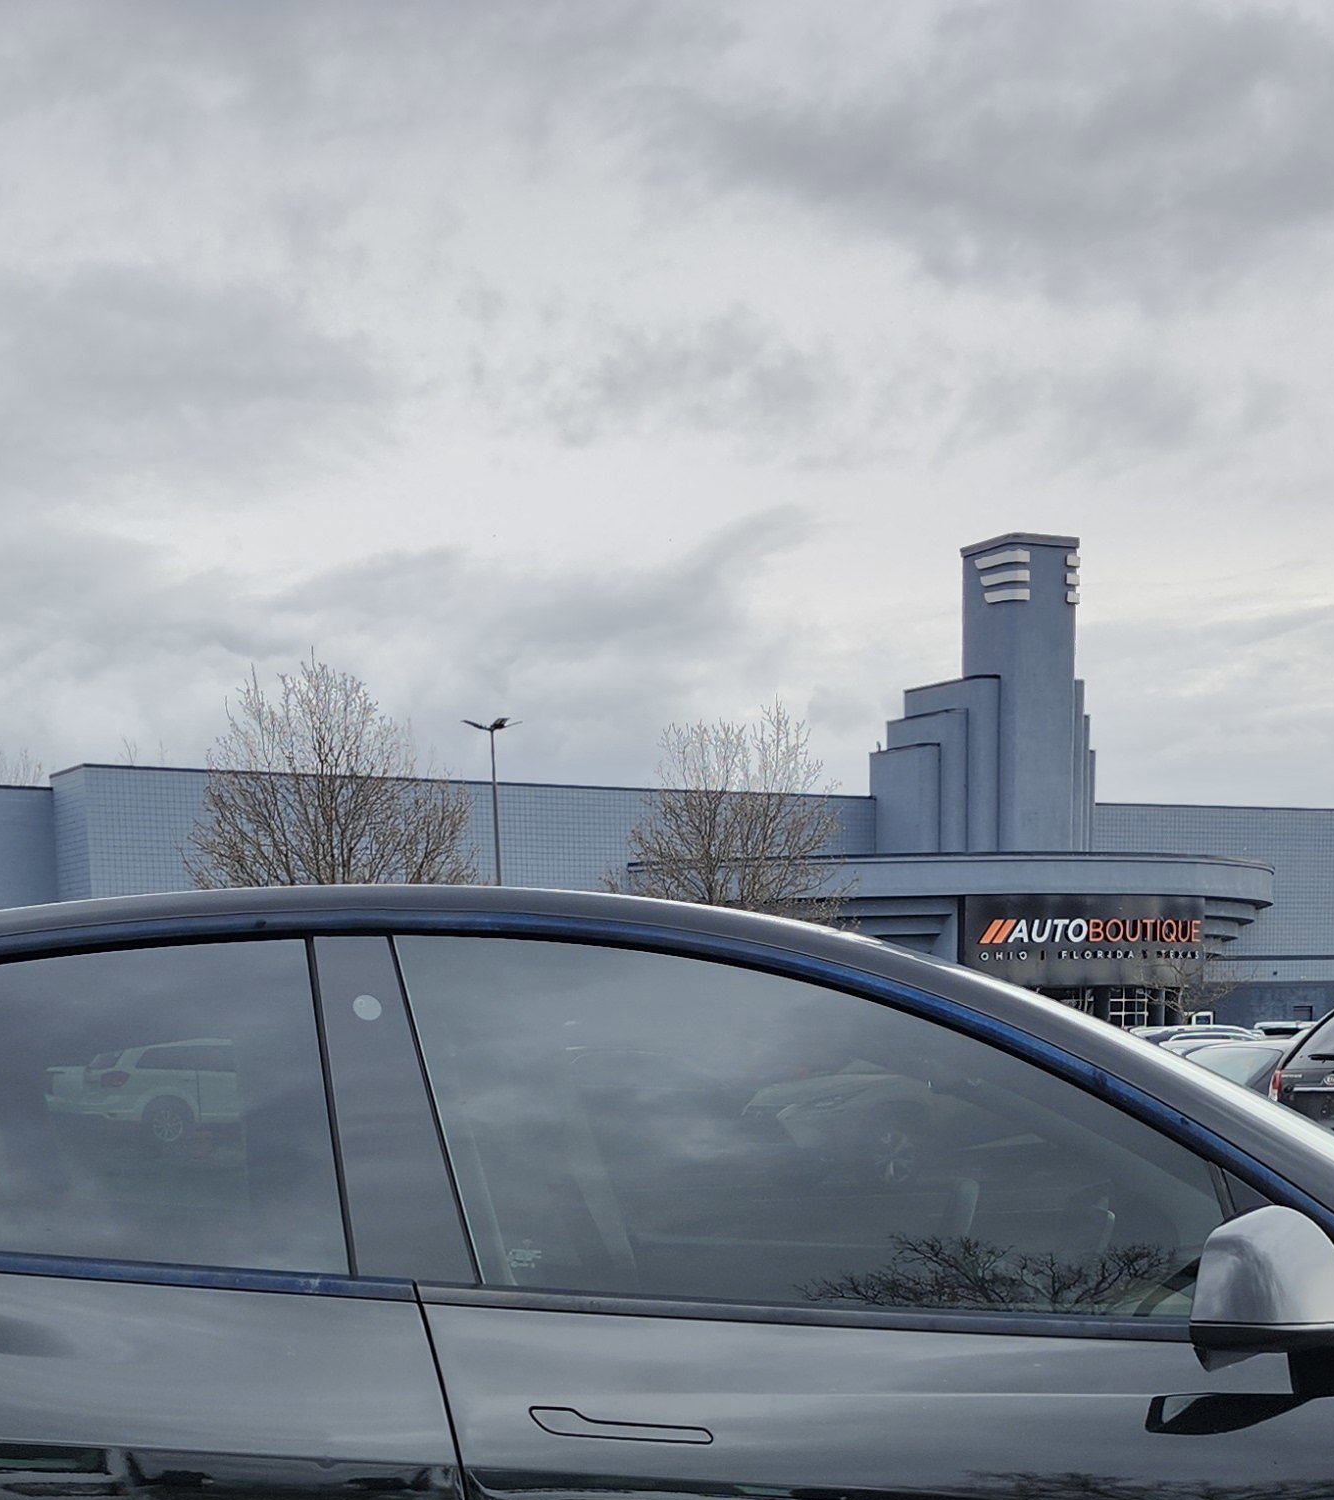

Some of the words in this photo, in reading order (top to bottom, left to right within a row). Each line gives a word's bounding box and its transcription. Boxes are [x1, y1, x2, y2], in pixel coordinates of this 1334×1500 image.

[1007, 918, 1202, 943] AUTOBOUTIQUE
[980, 951, 1028, 961] OHIO
[1061, 949, 1135, 960] FLORIDA
[1161, 949, 1199, 960] TEXAS
